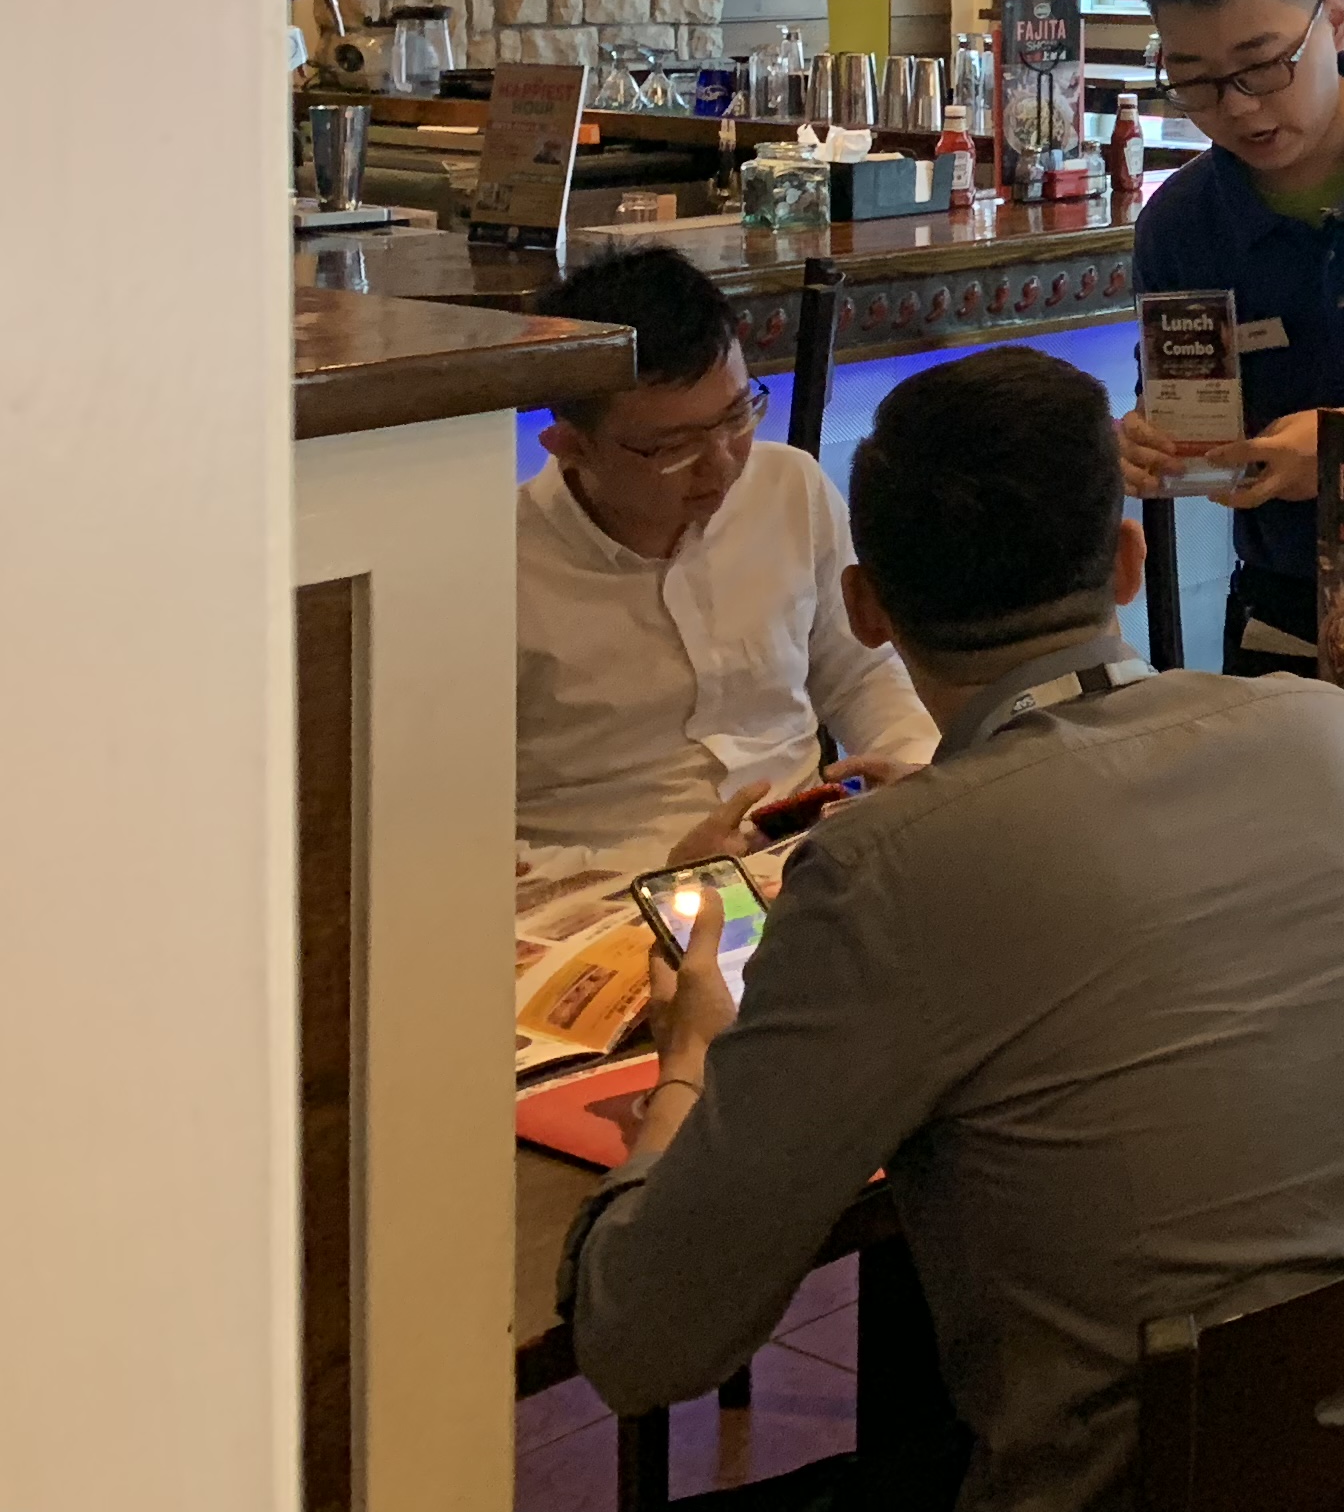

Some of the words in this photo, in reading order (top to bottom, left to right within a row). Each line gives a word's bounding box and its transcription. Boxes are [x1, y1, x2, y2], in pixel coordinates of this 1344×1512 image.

[1016, 19, 1066, 41] FAJITA
[1161, 313, 1214, 332] Lunch
[1162, 340, 1215, 356] Combo
